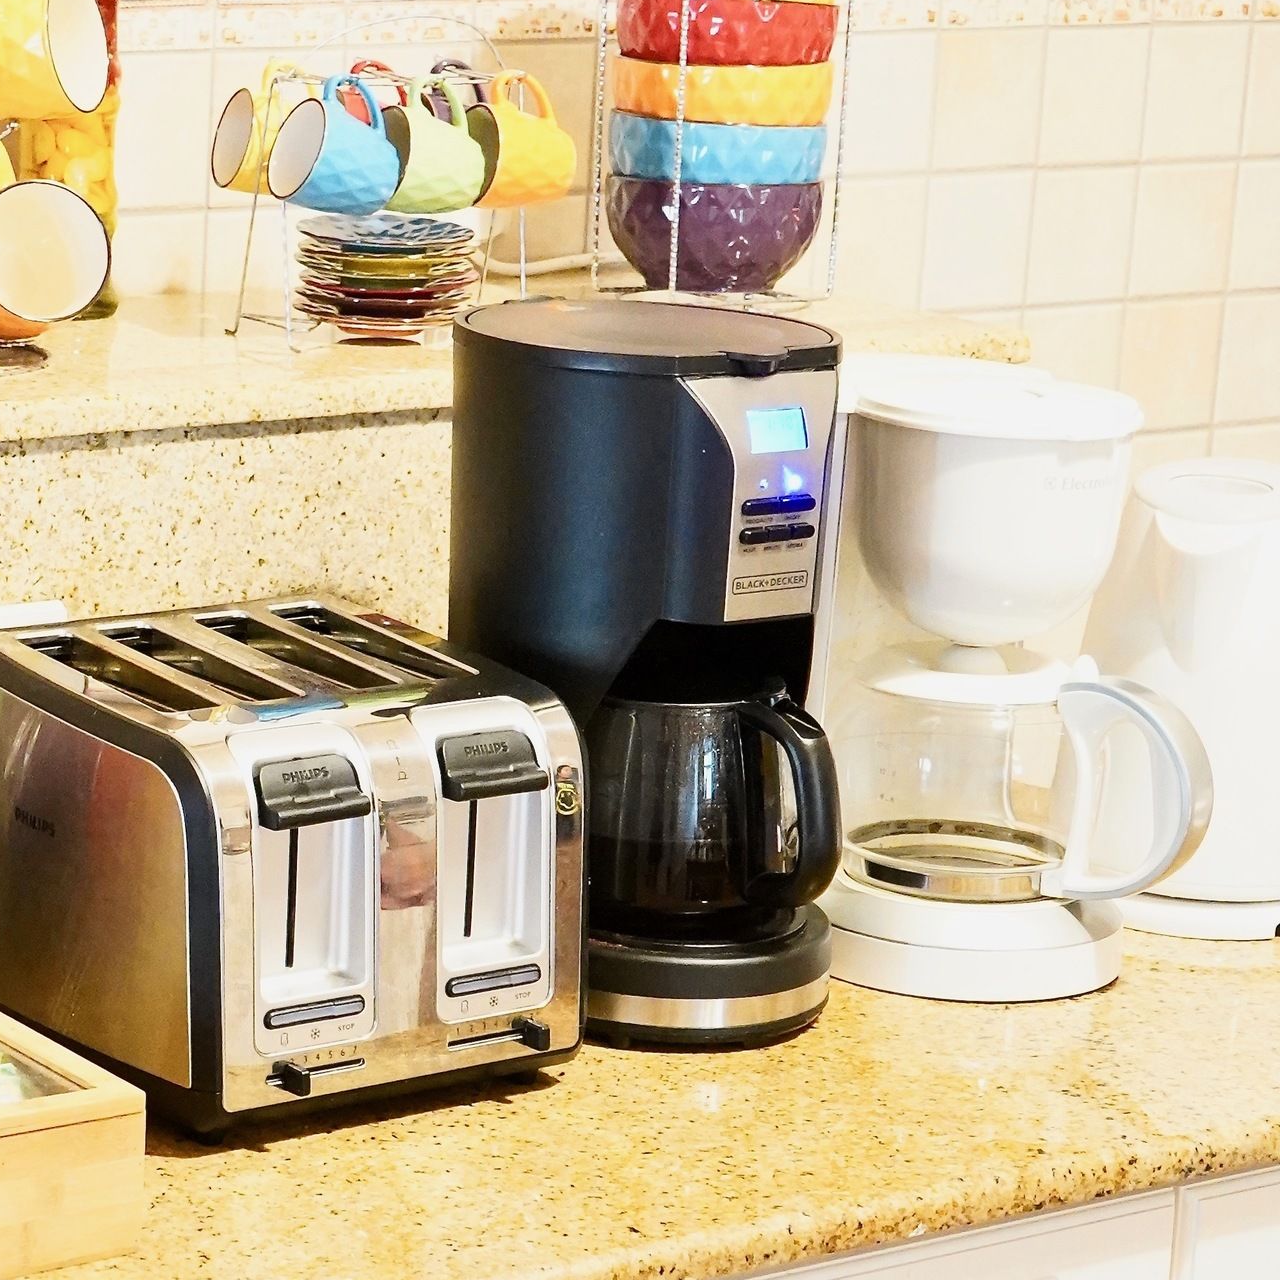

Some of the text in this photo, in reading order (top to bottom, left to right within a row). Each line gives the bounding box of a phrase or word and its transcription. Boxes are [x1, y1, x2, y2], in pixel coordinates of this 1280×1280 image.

[464, 741, 509, 757] PHILIPS
[282, 766, 329, 784] PHILIPS
[15, 807, 55, 838] PHILIPS
[515, 991, 531, 1000] STOP
[338, 1023, 354, 1031] STOP
